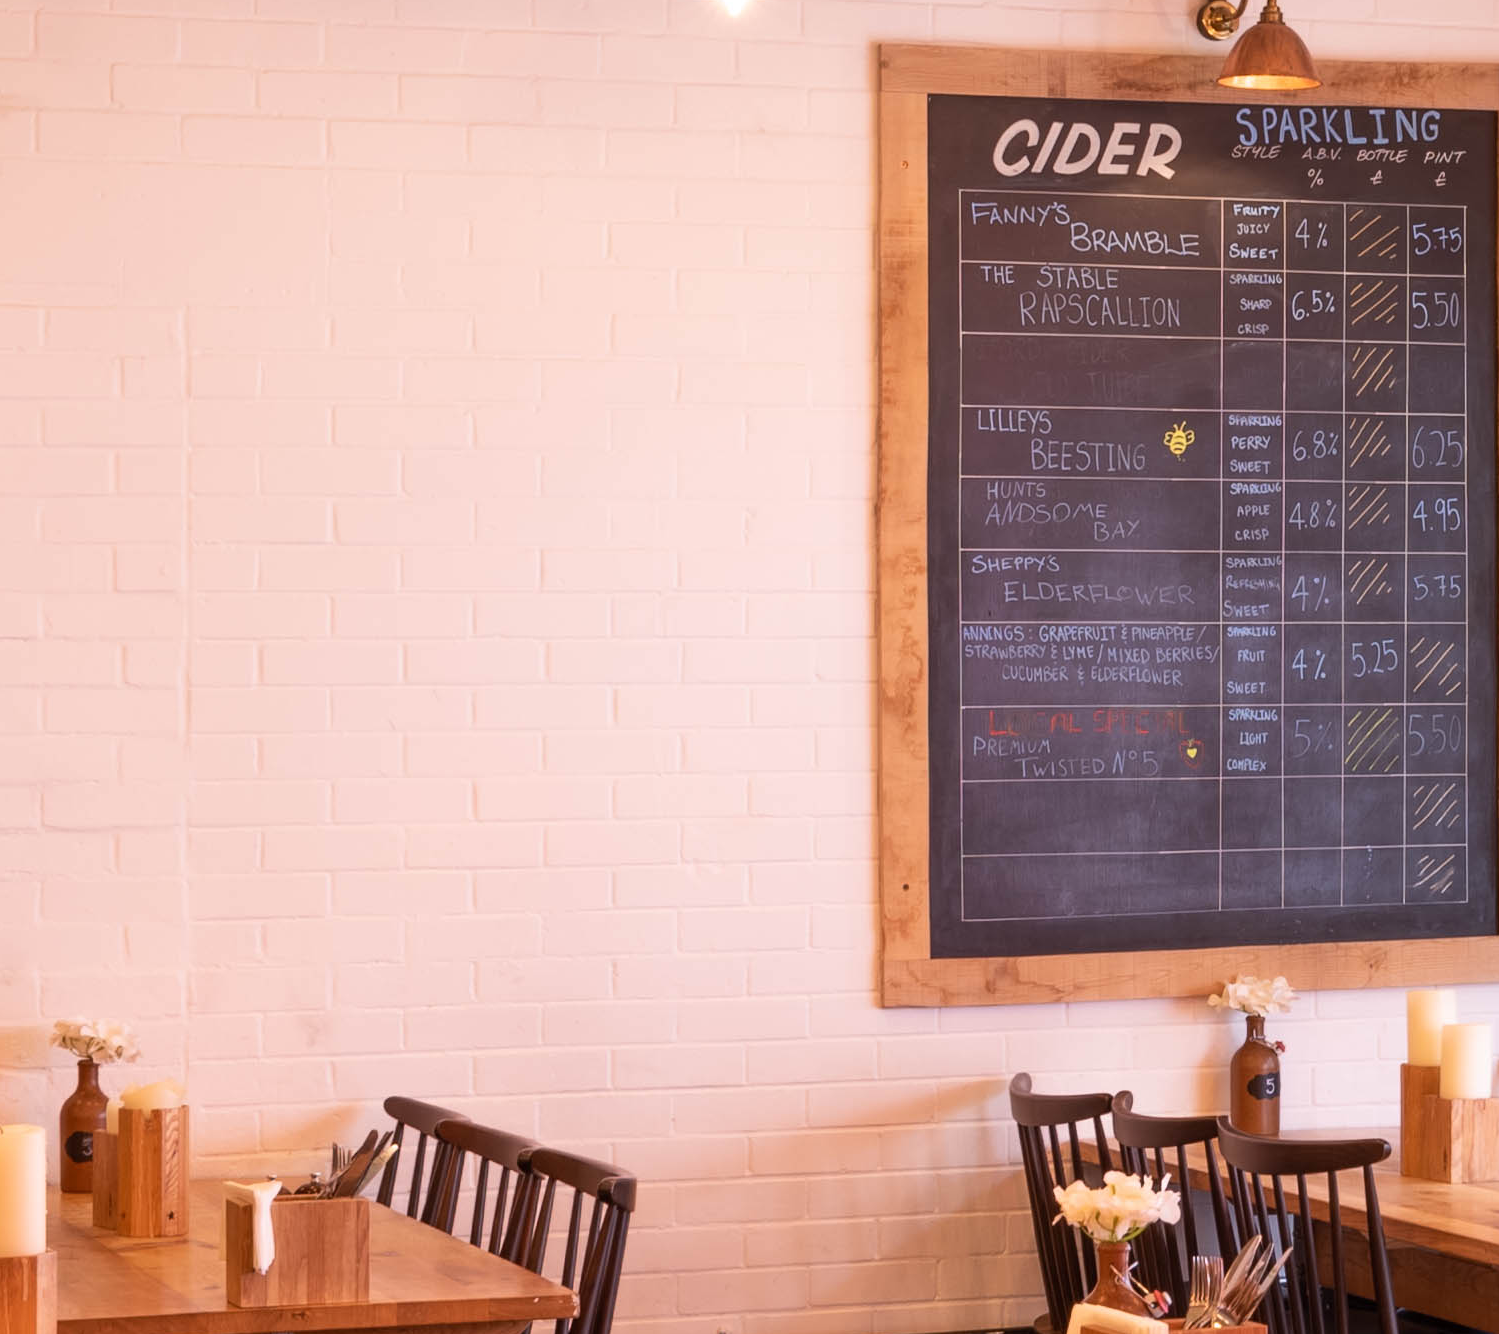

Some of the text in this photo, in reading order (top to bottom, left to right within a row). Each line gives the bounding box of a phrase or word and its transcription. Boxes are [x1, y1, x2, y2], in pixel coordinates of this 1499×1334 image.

[1236, 108, 1441, 146] SPARKLING
[993, 119, 1182, 180] CIDER
[1231, 145, 1281, 159] STYLE
[1357, 149, 1408, 162] BOTTLE
[1424, 150, 1466, 164] PINT
[1237, 224, 1269, 235] JUICY
[1413, 224, 1462, 255] 5.75
[1229, 243, 1278, 260] SWEET
[981, 266, 1119, 289] THE STABLE
[1020, 291, 1180, 328] RAPSCALLION
[1239, 299, 1272, 310] SHARP
[1413, 292, 1459, 329] 5.50
[1238, 324, 1269, 334] CRISP
[978, 409, 1051, 434] LILLEYS
[1231, 436, 1271, 450] PERRY
[1031, 438, 1145, 472] BEESTING
[1230, 460, 1270, 474] SWEET
[987, 482, 1045, 500] HUNTS
[985, 502, 1108, 526] ANDSOME
[1237, 505, 1270, 516] APPLE
[1413, 498, 1461, 532] 4.95
[1094, 520, 1140, 542] BAY
[1235, 530, 1269, 541] CRISP
[1004, 582, 1195, 604] ELDERFLOWER
[1108, 647, 1150, 663] MIXED
[1238, 650, 1265, 662] FRUIT
[1352, 640, 1398, 678] 5.25
[1227, 682, 1265, 694] SWEET
[973, 736, 1050, 756] PREMIUM
[1239, 732, 1268, 745] LIGHT
[1266, 1078, 1274, 1094] 5
